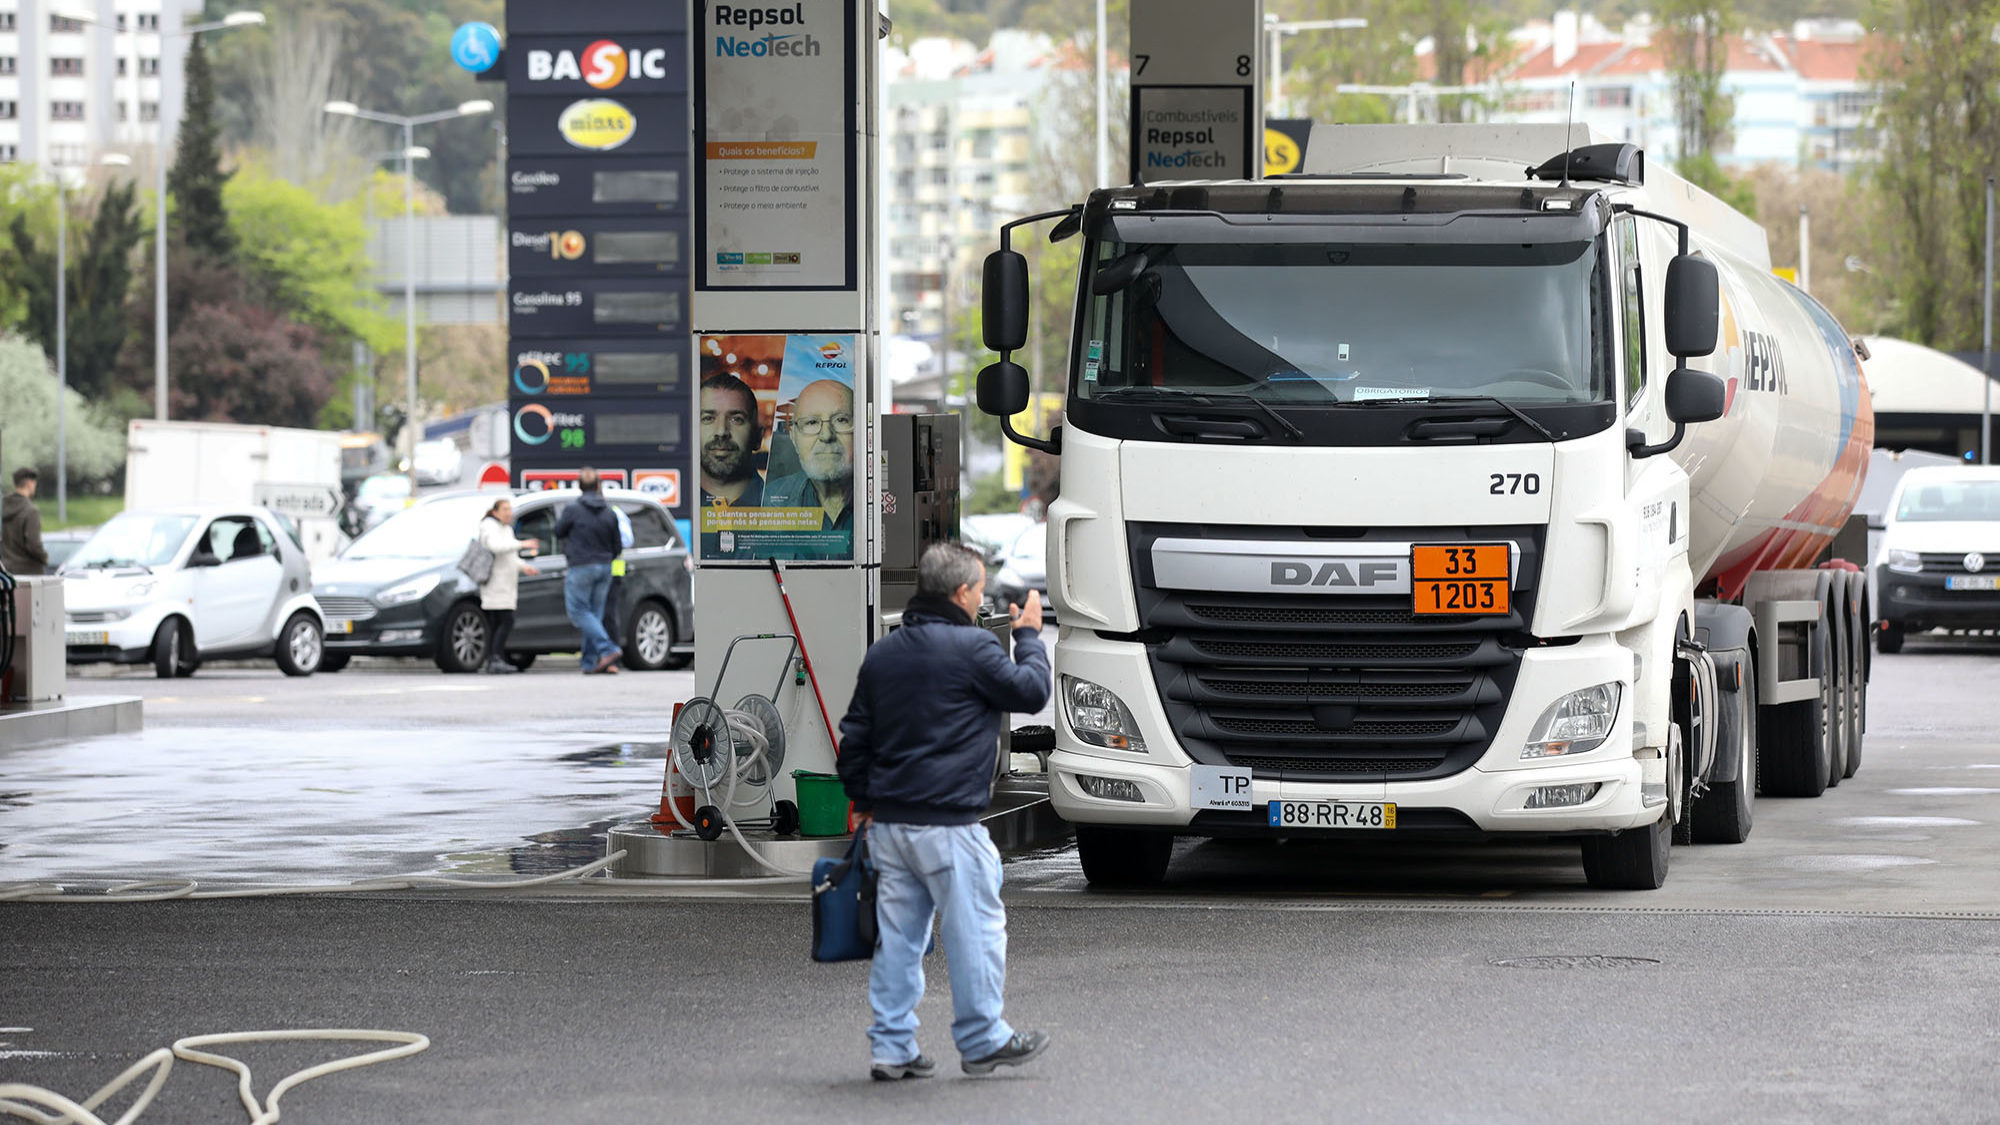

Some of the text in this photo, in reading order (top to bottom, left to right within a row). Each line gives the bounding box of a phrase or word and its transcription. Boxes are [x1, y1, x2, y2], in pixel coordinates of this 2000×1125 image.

[715, 2, 805, 31] Repsol
[527, 44, 666, 84] BASIC
[1135, 55, 1150, 76] 7
[1236, 54, 1251, 77] 8
[1147, 127, 1214, 148] Repsol
[719, 146, 743, 157] Quais
[744, 148, 755, 156] os
[723, 167, 750, 177] Protege
[785, 167, 794, 175] de
[723, 185, 749, 194] Protege
[723, 202, 750, 211] Protege
[512, 230, 586, 260] Diesel 10
[513, 291, 564, 306] Gasolina
[564, 352, 590, 373] 95
[1742, 329, 1788, 396] REPSOL
[560, 428, 586, 448] 98
[1489, 473, 1541, 495] 270
[706, 519, 732, 527] porque
[733, 518, 747, 526] nós
[749, 518, 757, 526] só
[759, 519, 796, 527] pensamos
[718, 510, 747, 518] clientes
[749, 511, 784, 519] pensaram
[800, 510, 812, 518] nós
[1445, 548, 1477, 575] 33
[1270, 562, 1398, 587] DAF
[1430, 582, 1495, 609] 1203
[1219, 775, 1250, 794] TP
[1272, 815, 1279, 823] P
[1387, 806, 1395, 814] 16
[1385, 819, 1395, 827] 07
